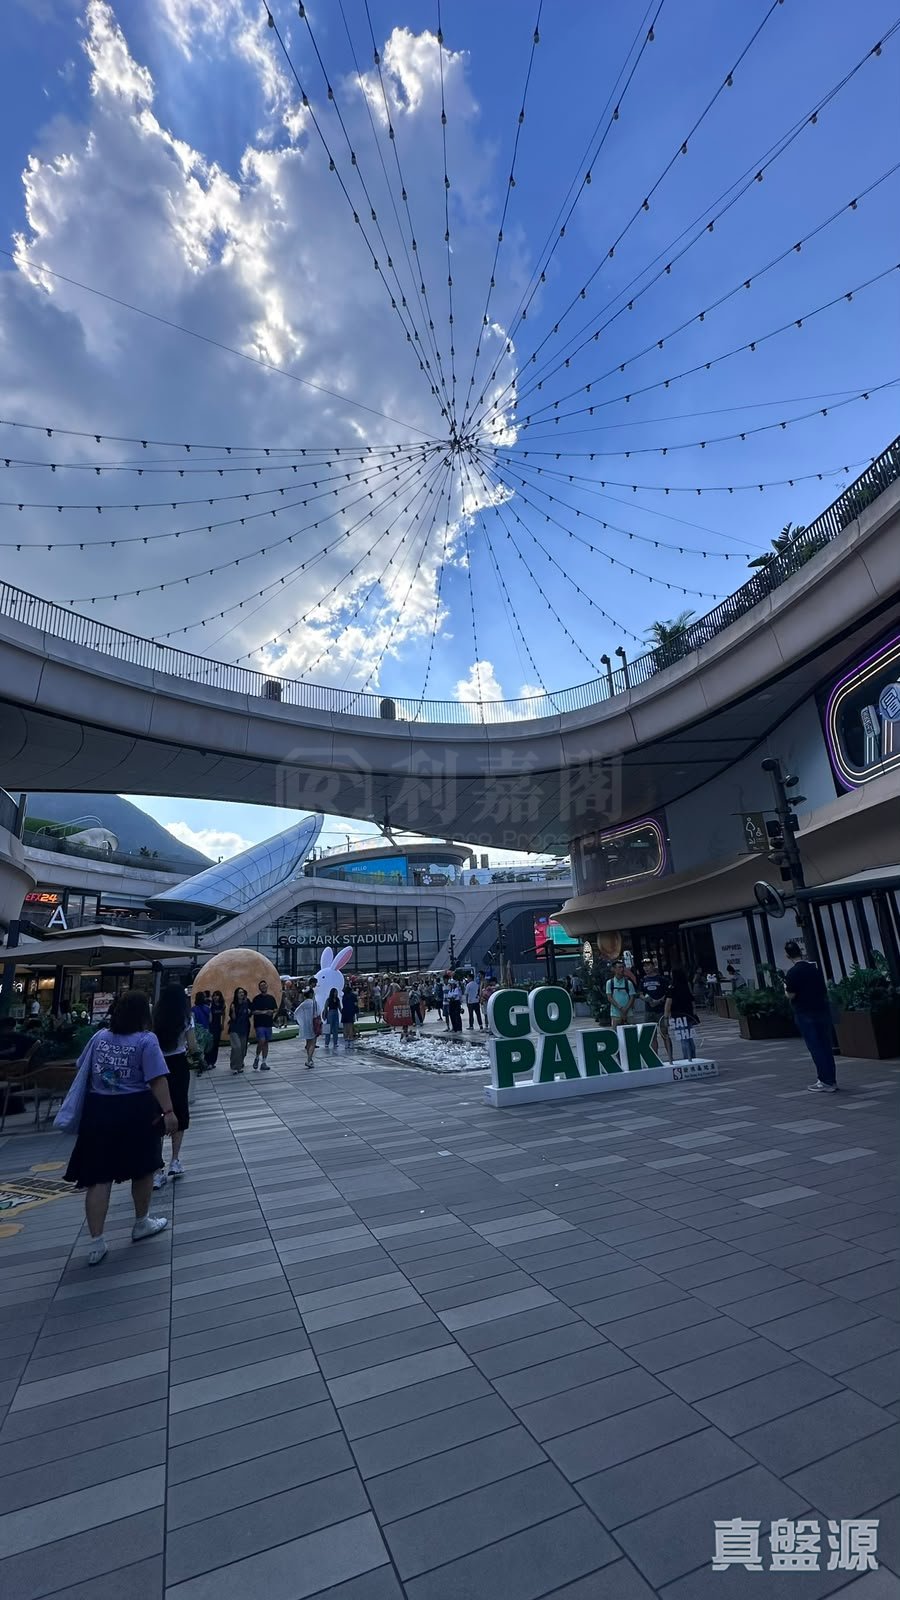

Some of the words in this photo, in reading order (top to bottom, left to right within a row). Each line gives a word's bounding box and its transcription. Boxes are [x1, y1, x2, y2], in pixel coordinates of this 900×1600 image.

[47, 904, 68, 930] A
[309, 935, 340, 945] PARK
[343, 933, 398, 944] STADIUM
[488, 986, 573, 1038] GO
[669, 1016, 688, 1030] SAI
[490, 1022, 664, 1089] PARK
